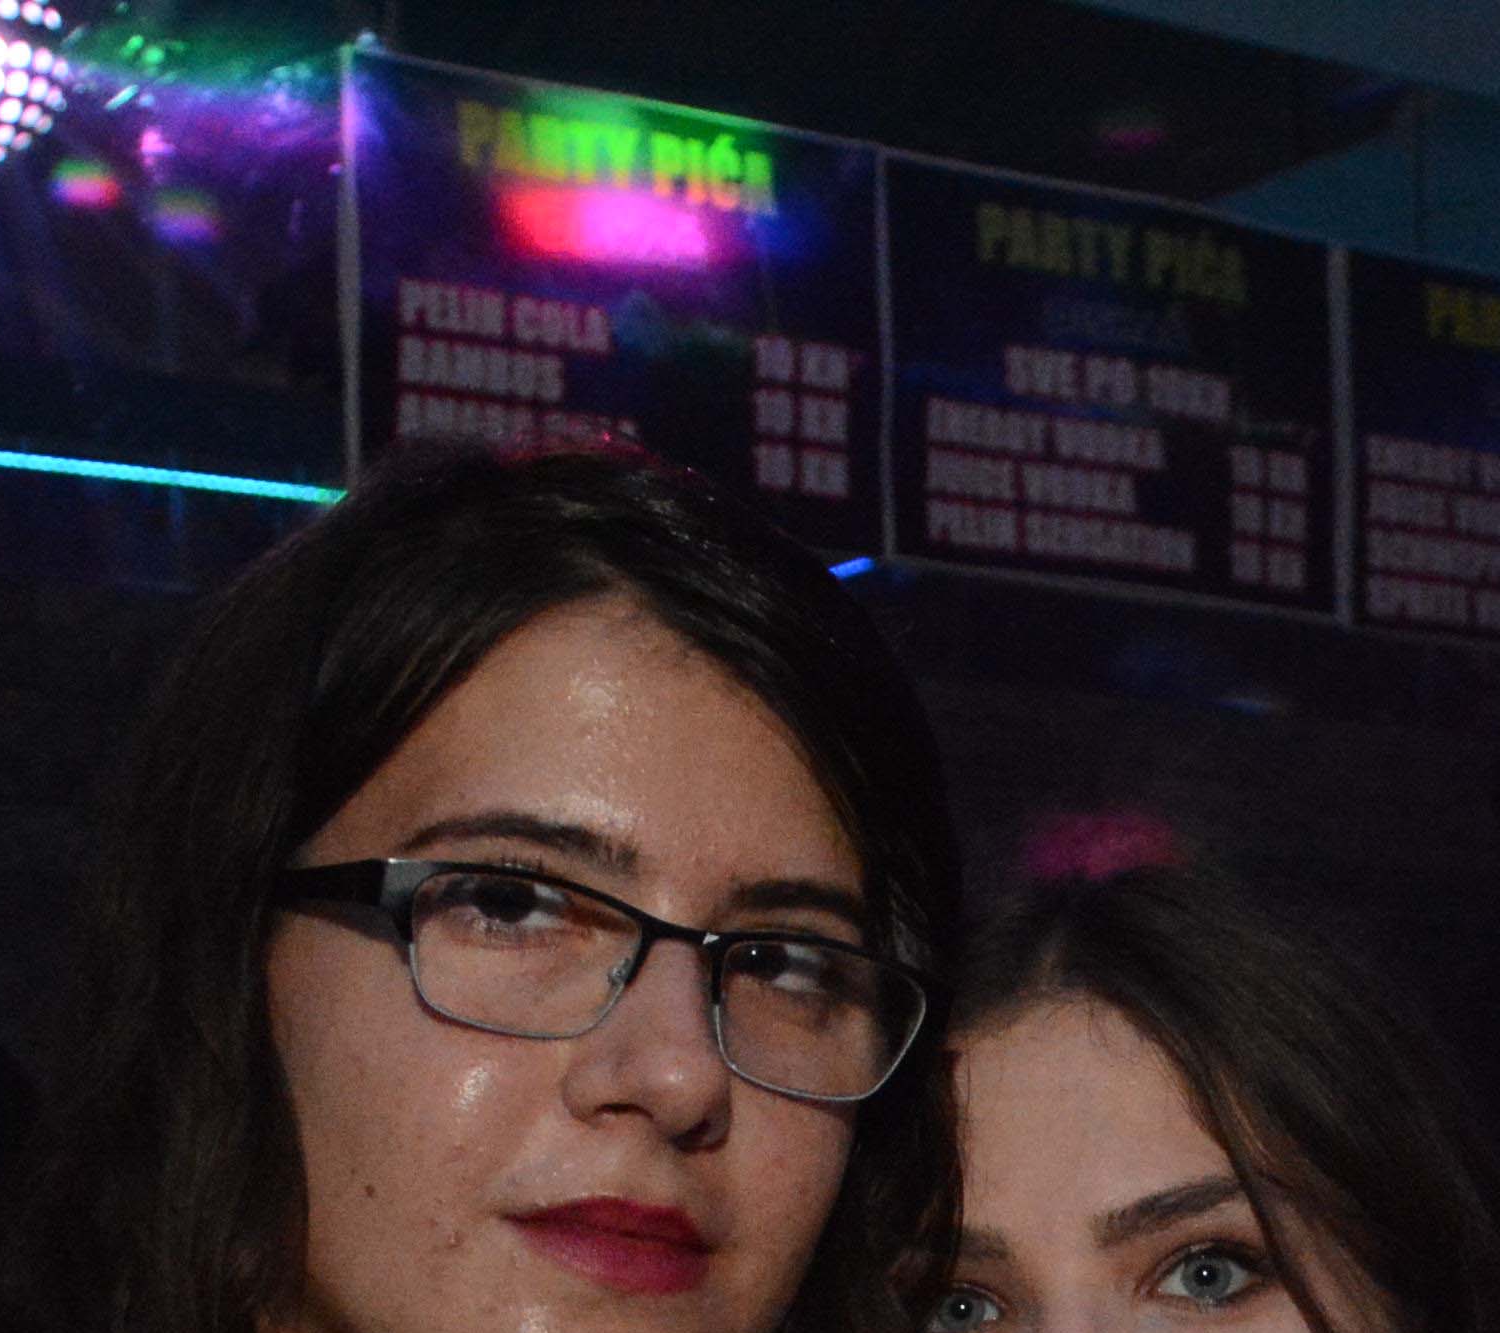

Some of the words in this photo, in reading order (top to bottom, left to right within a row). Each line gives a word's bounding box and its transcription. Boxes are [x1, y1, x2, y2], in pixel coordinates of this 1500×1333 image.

[456, 99, 642, 188] PARTY
[649, 131, 779, 216] PIĆA
[976, 202, 1134, 286] PARTY
[399, 277, 505, 336] PELIN
[512, 296, 613, 355] COLA
[1004, 345, 1078, 403] SVE
[1084, 356, 1138, 407] PO
[1054, 416, 1168, 472] VODKA
[1022, 462, 1137, 516] VODKA
